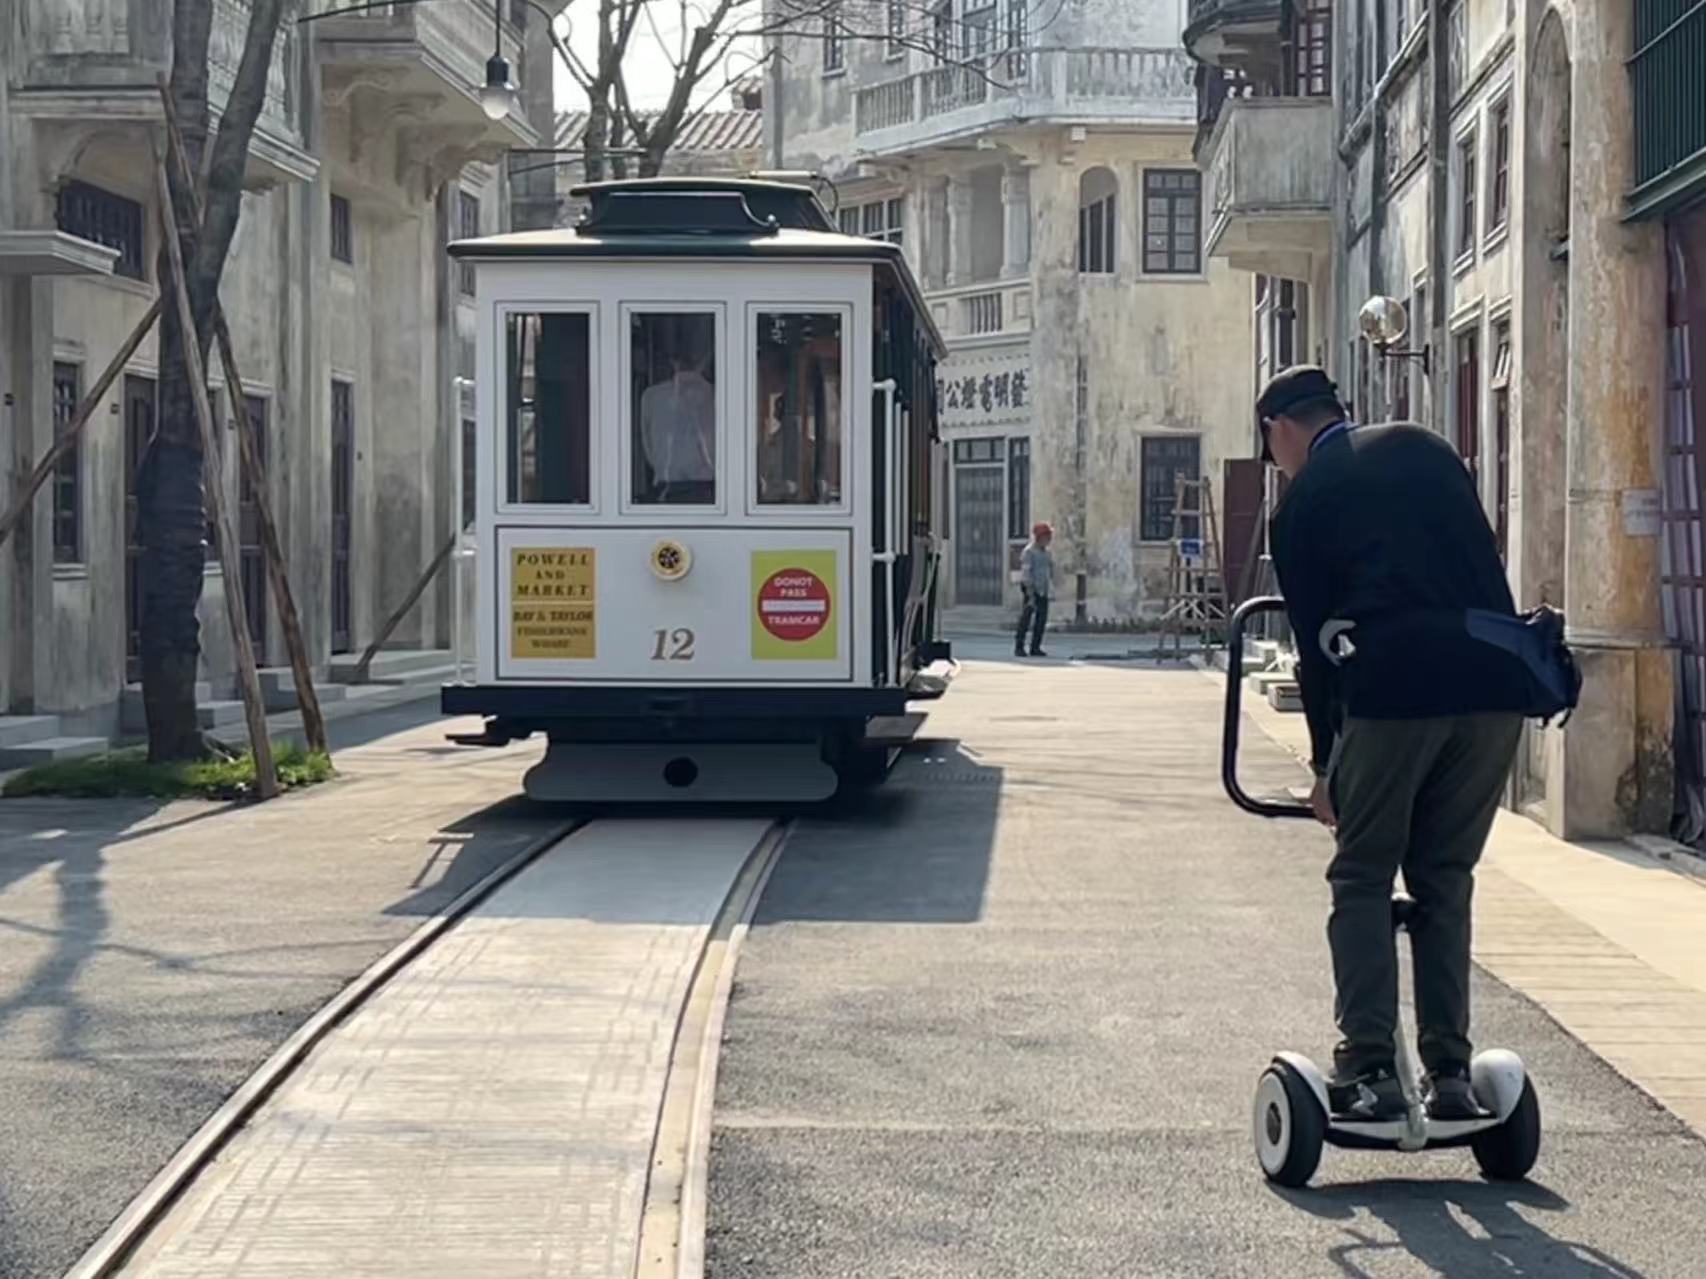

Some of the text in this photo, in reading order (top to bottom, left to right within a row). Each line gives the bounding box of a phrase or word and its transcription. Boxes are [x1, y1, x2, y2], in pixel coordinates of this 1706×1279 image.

[517, 553, 588, 566] POWELL
[536, 570, 566, 580] AND
[516, 584, 588, 596] MARKET
[780, 588, 808, 598] PASS
[550, 611, 593, 622] TAYLOR
[767, 615, 820, 625] TRAMCAR
[650, 628, 696, 661] 12
